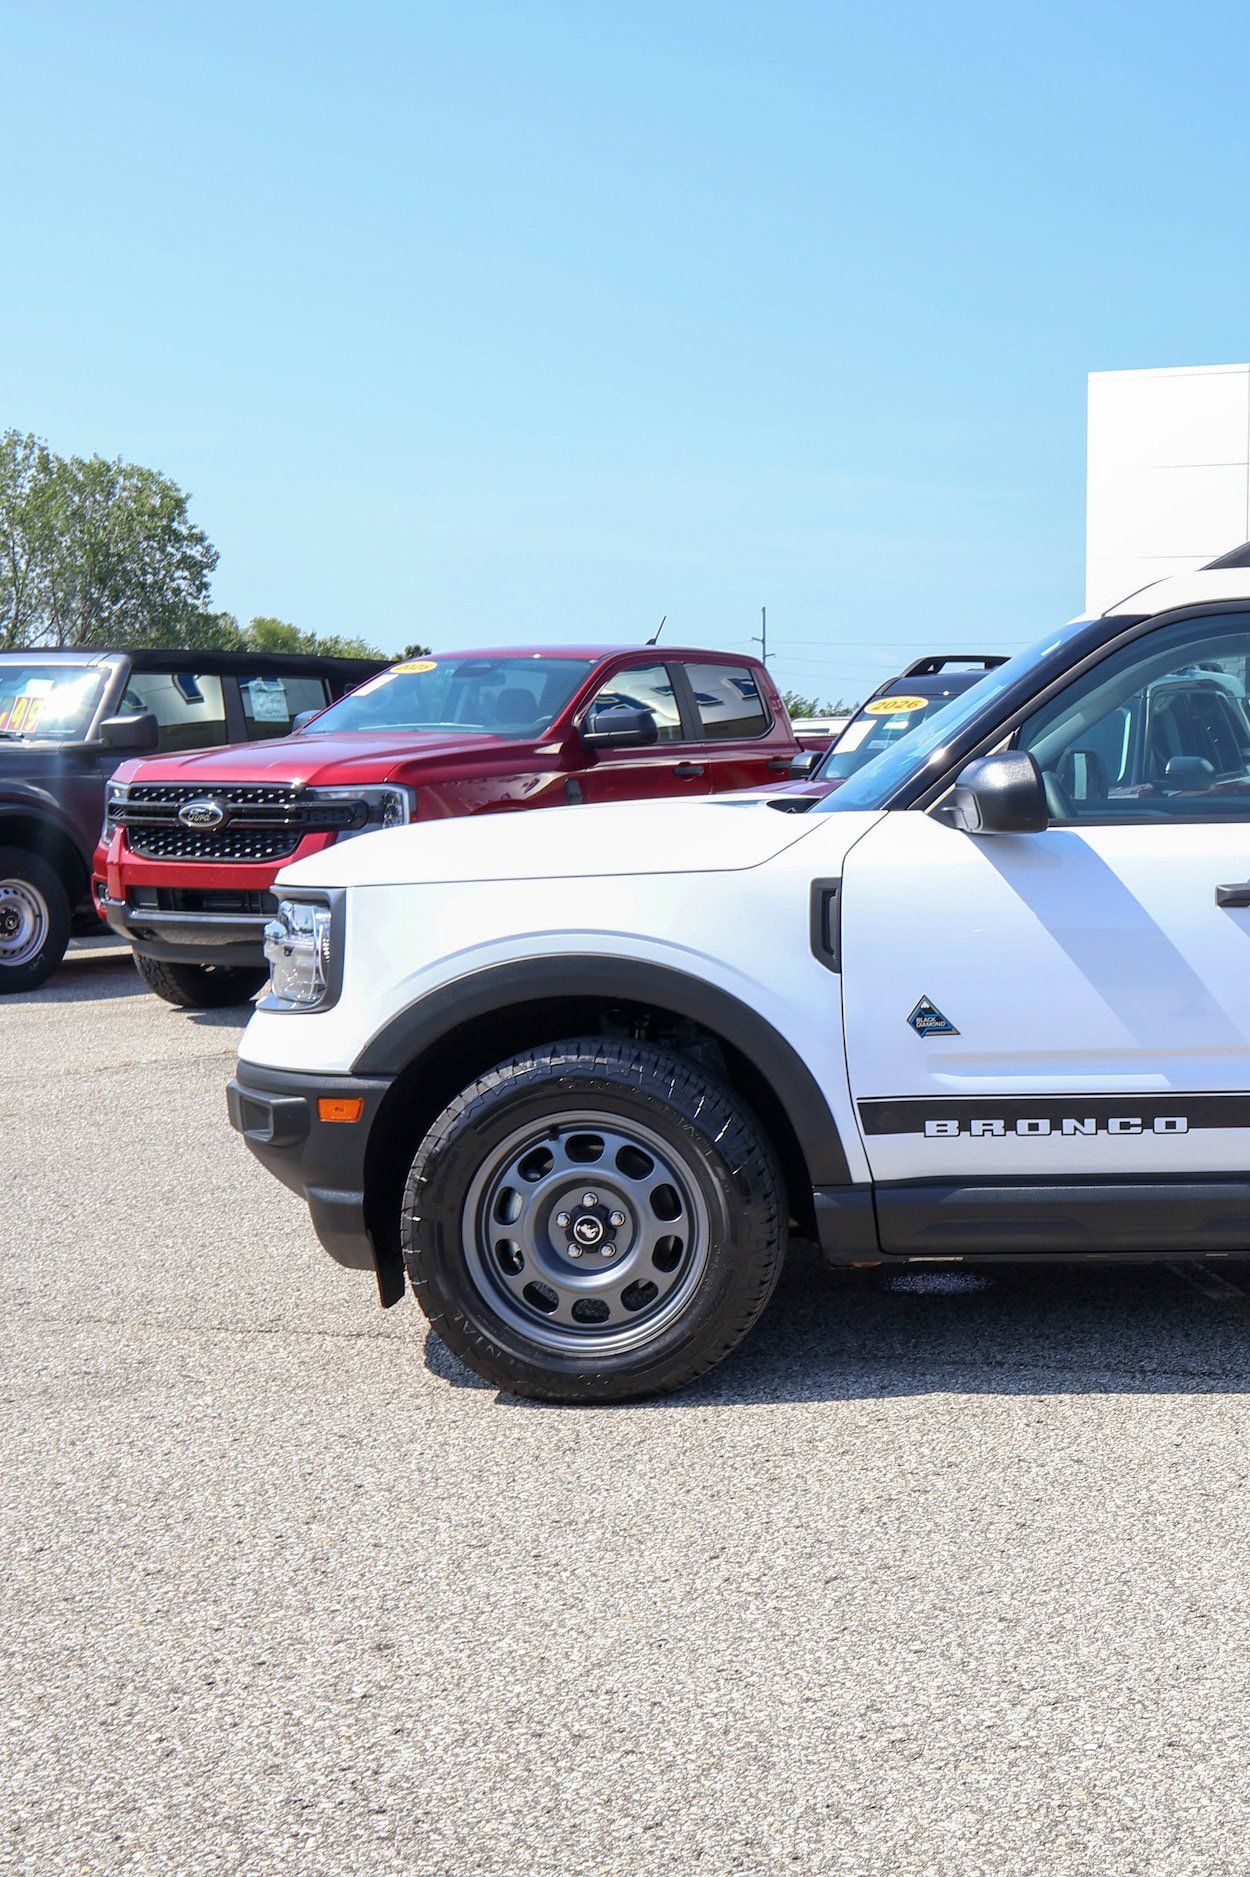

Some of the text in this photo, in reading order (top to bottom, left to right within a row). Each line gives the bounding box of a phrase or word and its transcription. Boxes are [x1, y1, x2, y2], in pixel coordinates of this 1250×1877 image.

[871, 700, 922, 711] 2026
[187, 808, 213, 822] Ford
[924, 1116, 1190, 1138] BRONCO
